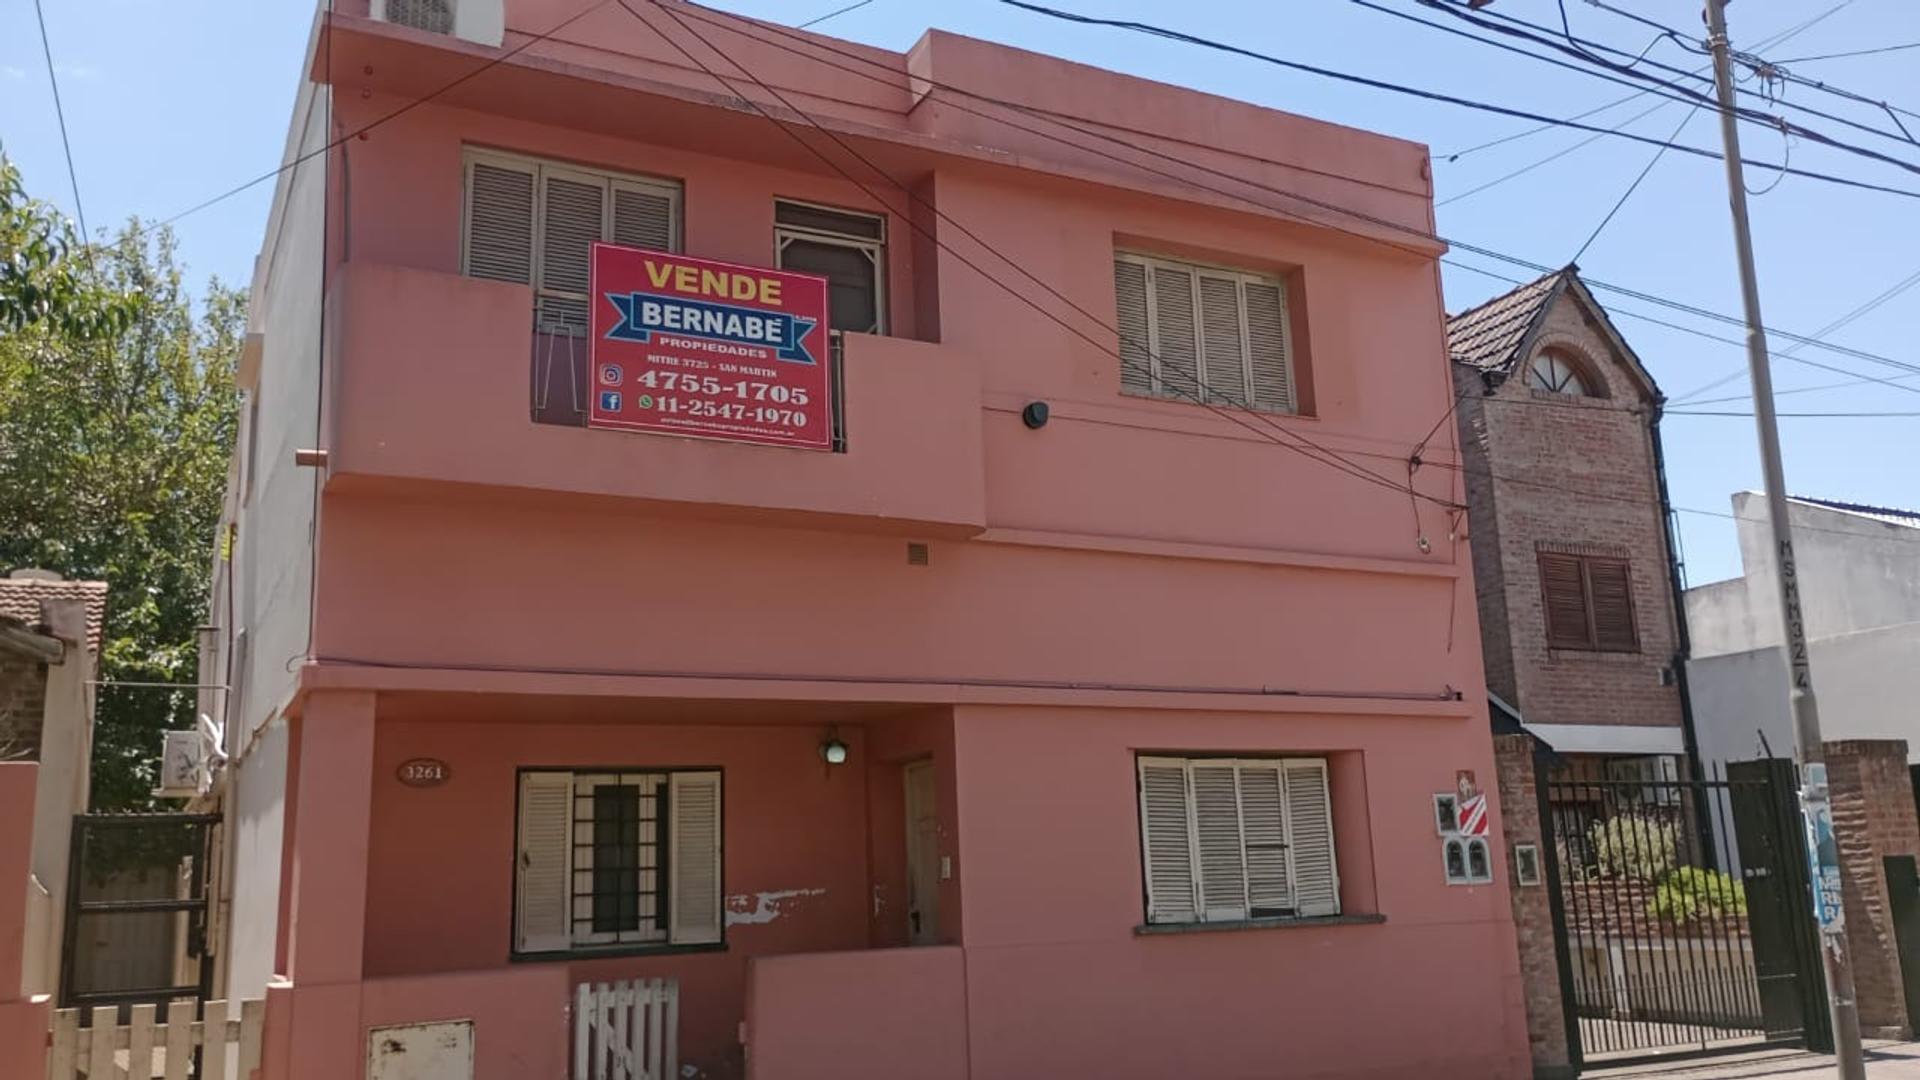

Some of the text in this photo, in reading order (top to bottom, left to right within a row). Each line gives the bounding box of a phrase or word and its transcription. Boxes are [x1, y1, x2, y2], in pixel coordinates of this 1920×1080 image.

[644, 260, 783, 306] VENDE
[642, 301, 783, 343] BERNABÉ
[660, 337, 767, 359] PROPIEDADES
[637, 370, 809, 406] 4755-1705
[657, 396, 807, 428] 11-2547-1970
[407, 766, 441, 779] 3261
